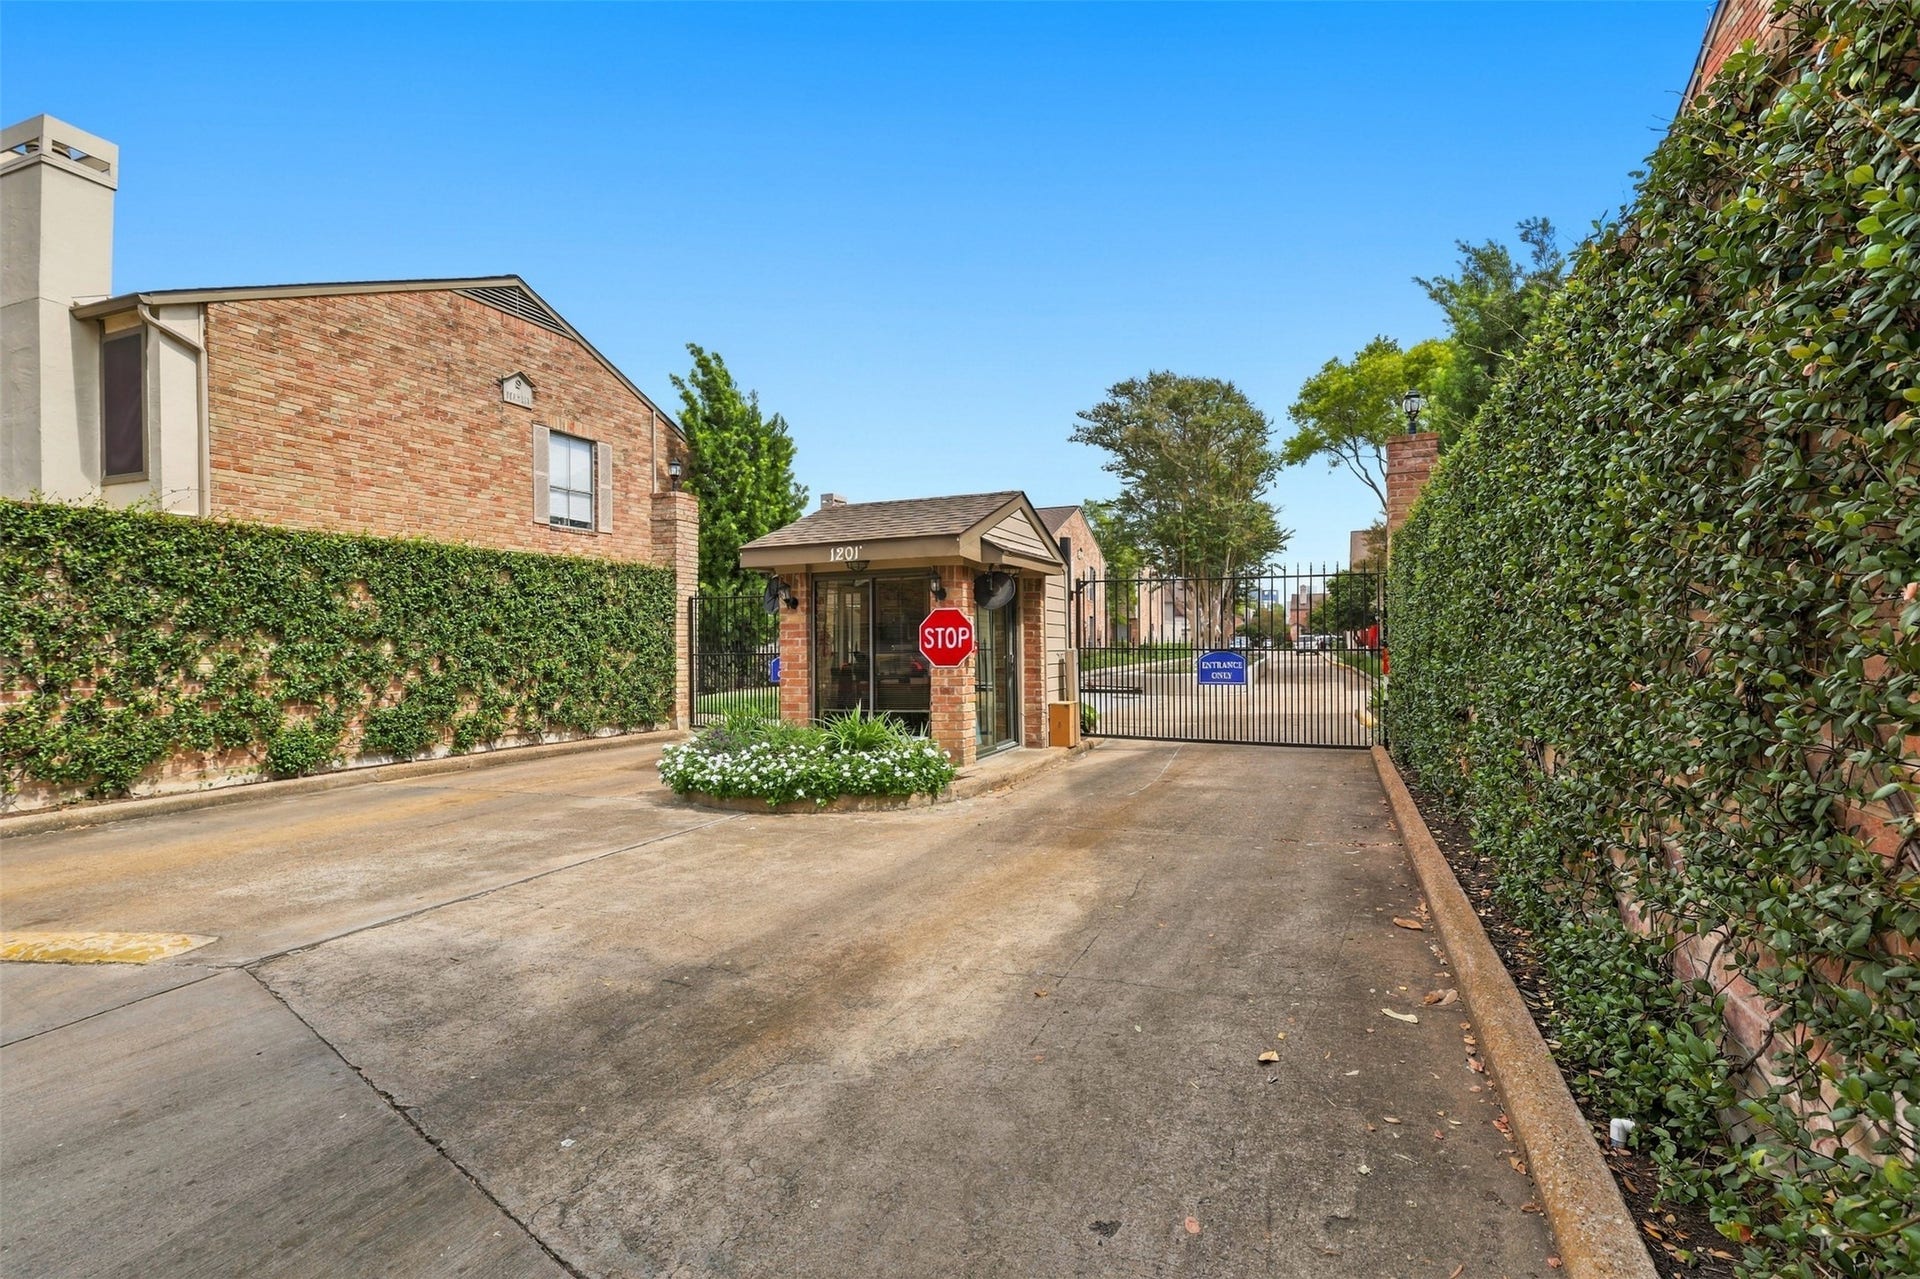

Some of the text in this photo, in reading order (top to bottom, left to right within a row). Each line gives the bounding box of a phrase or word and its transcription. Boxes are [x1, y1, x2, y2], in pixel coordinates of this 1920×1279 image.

[830, 546, 858, 561] 1201
[925, 627, 969, 648] STOP
[1201, 661, 1243, 669] ENTRANCE
[1211, 671, 1232, 680] ONLY
